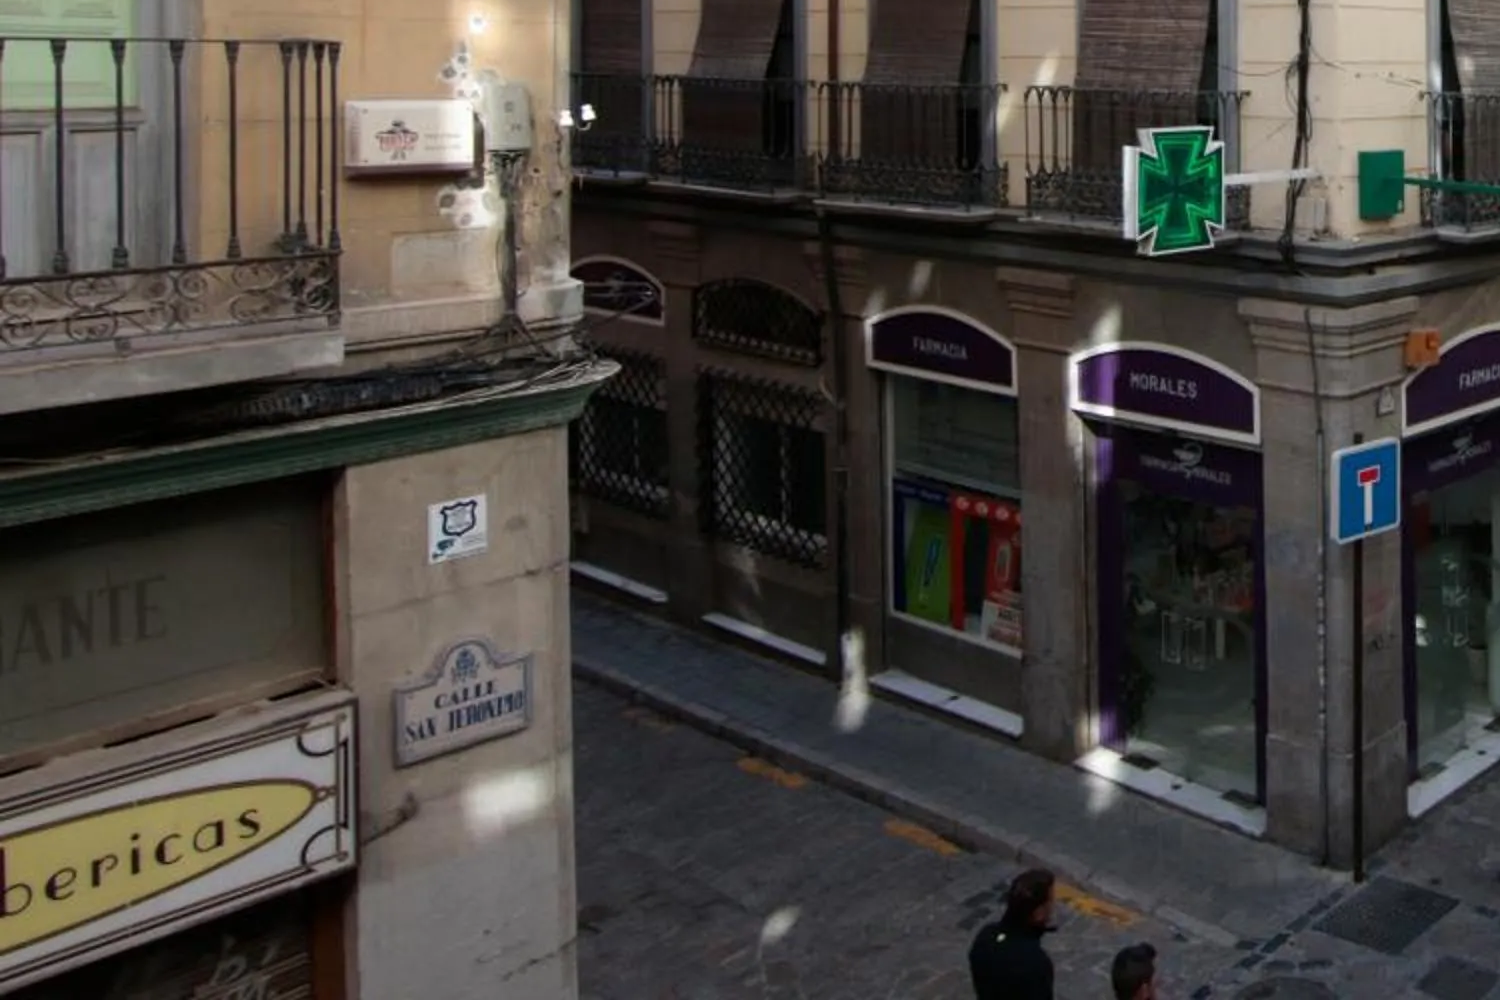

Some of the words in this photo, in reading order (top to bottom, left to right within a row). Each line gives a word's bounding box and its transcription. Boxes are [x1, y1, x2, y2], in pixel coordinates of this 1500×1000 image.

[1129, 371, 1198, 399] MORALES
[0, 568, 168, 676] ANTE
[434, 677, 497, 709] CALLE
[404, 716, 437, 746] SAN
